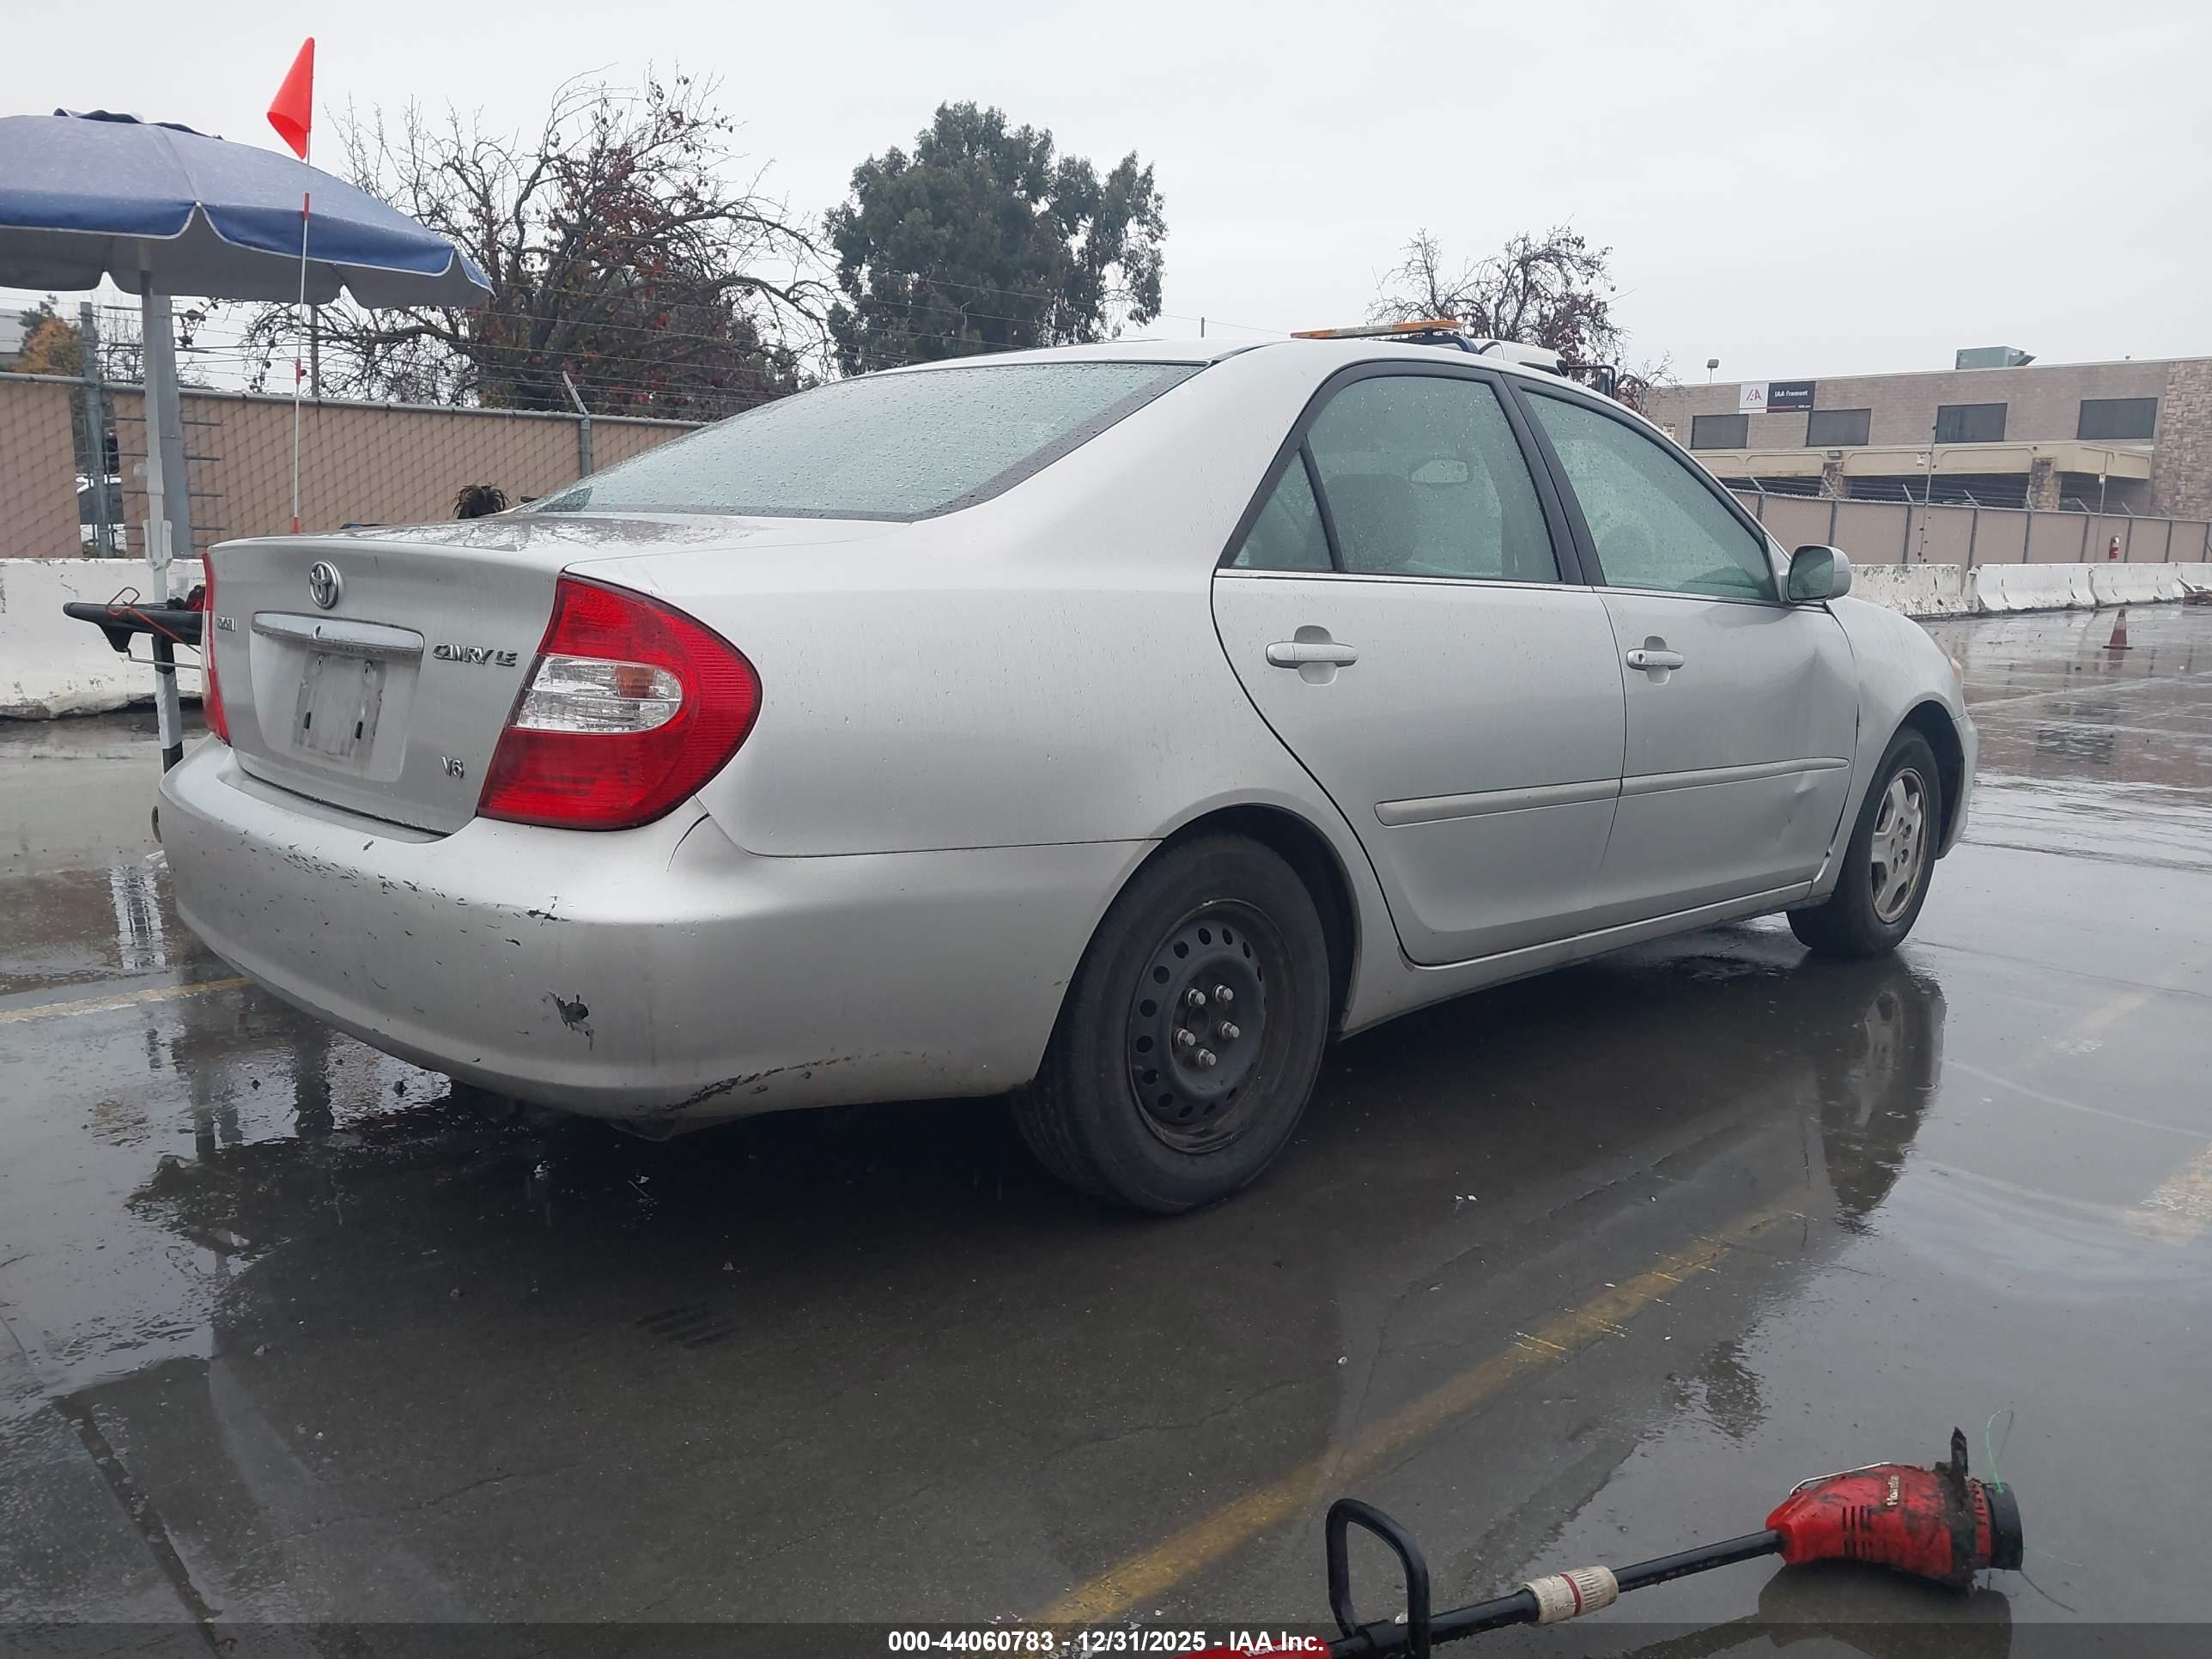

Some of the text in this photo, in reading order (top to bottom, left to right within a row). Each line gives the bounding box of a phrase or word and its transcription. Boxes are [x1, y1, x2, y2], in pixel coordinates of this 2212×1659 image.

[432, 643, 518, 667] CAMRY LE
[441, 755, 465, 779] V6
